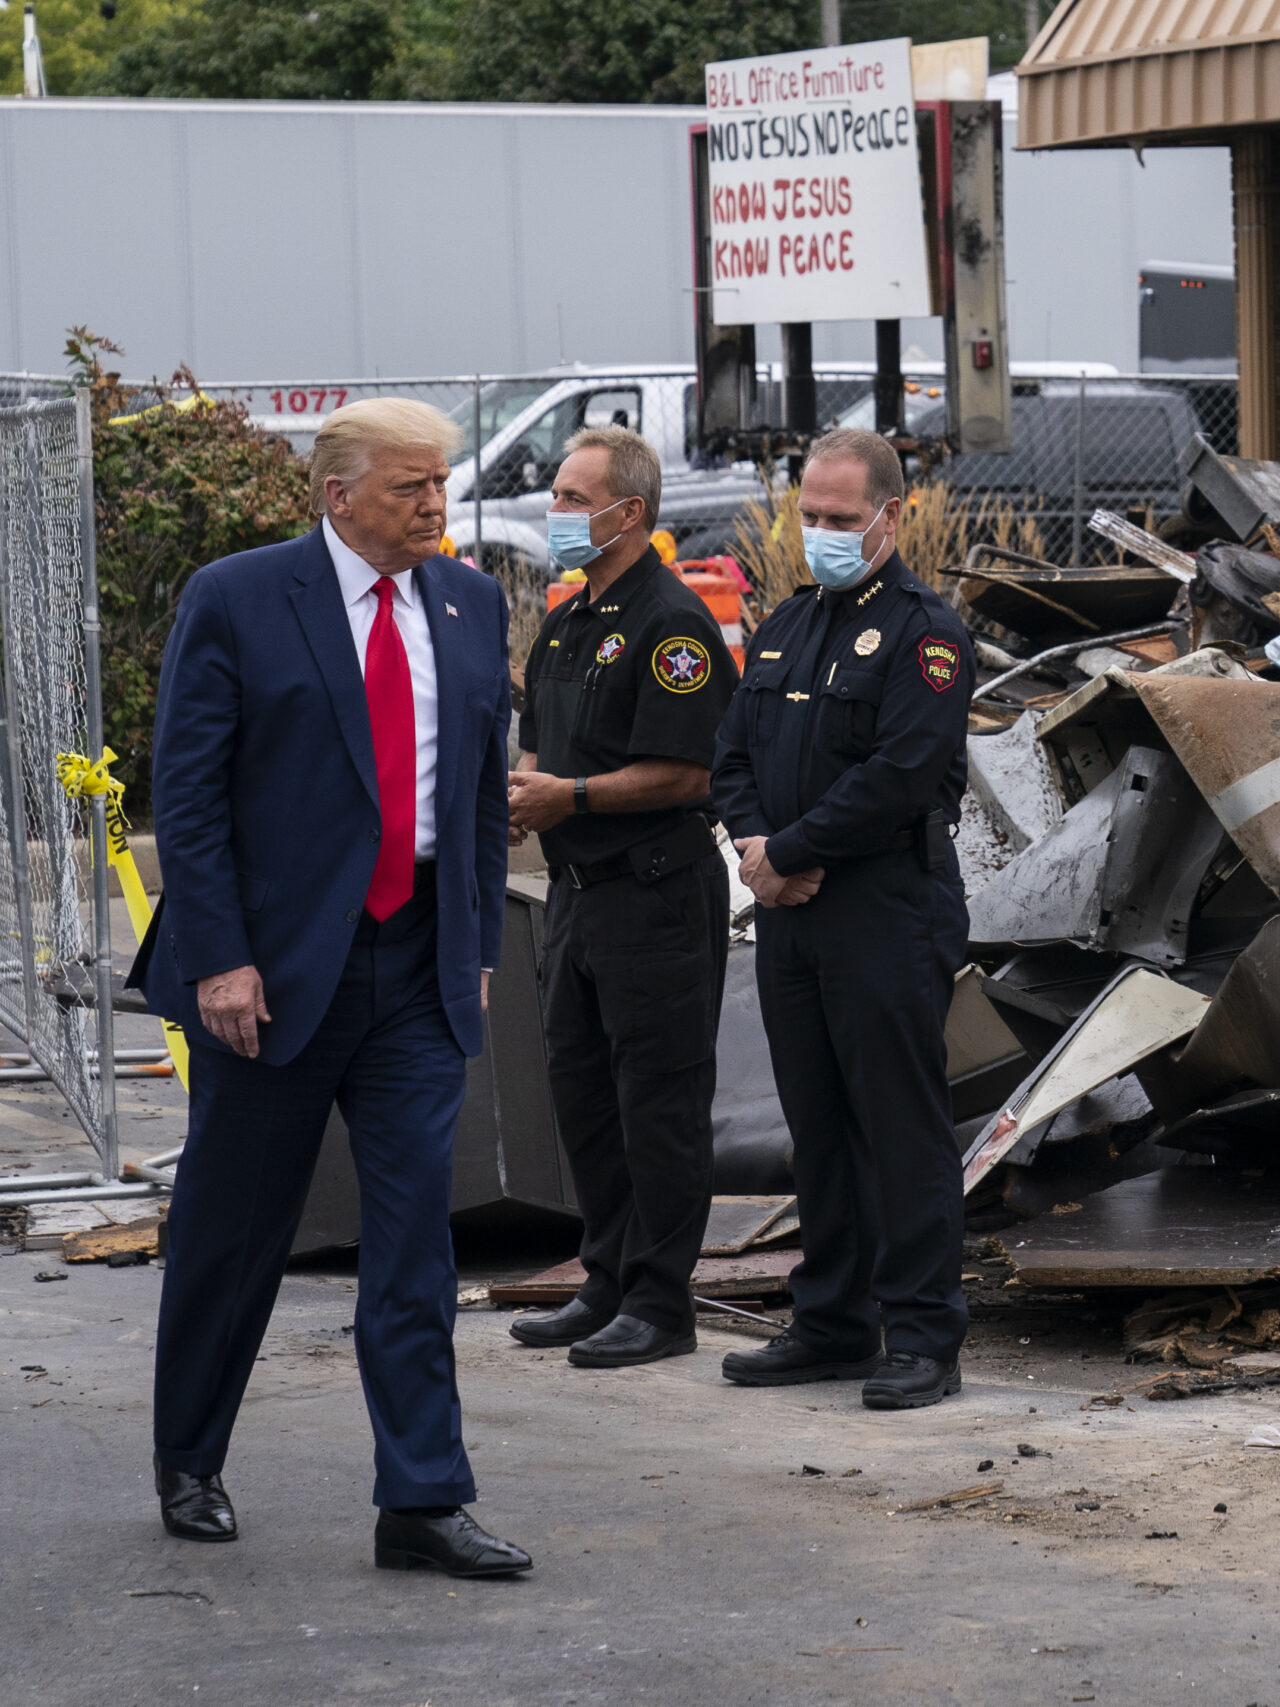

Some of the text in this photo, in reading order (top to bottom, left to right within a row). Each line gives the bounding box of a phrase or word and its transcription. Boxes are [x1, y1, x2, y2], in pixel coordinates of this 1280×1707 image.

[708, 57, 884, 108] B&L Office Furniture
[710, 121, 738, 161] NO
[741, 113, 810, 160] JESUS
[812, 110, 839, 155] NO
[772, 176, 852, 221] JESUS
[779, 230, 854, 277] PEACE
[269, 389, 348, 414] 1077
[924, 646, 956, 664] KENOSHA
[928, 665, 951, 680] POLICE
